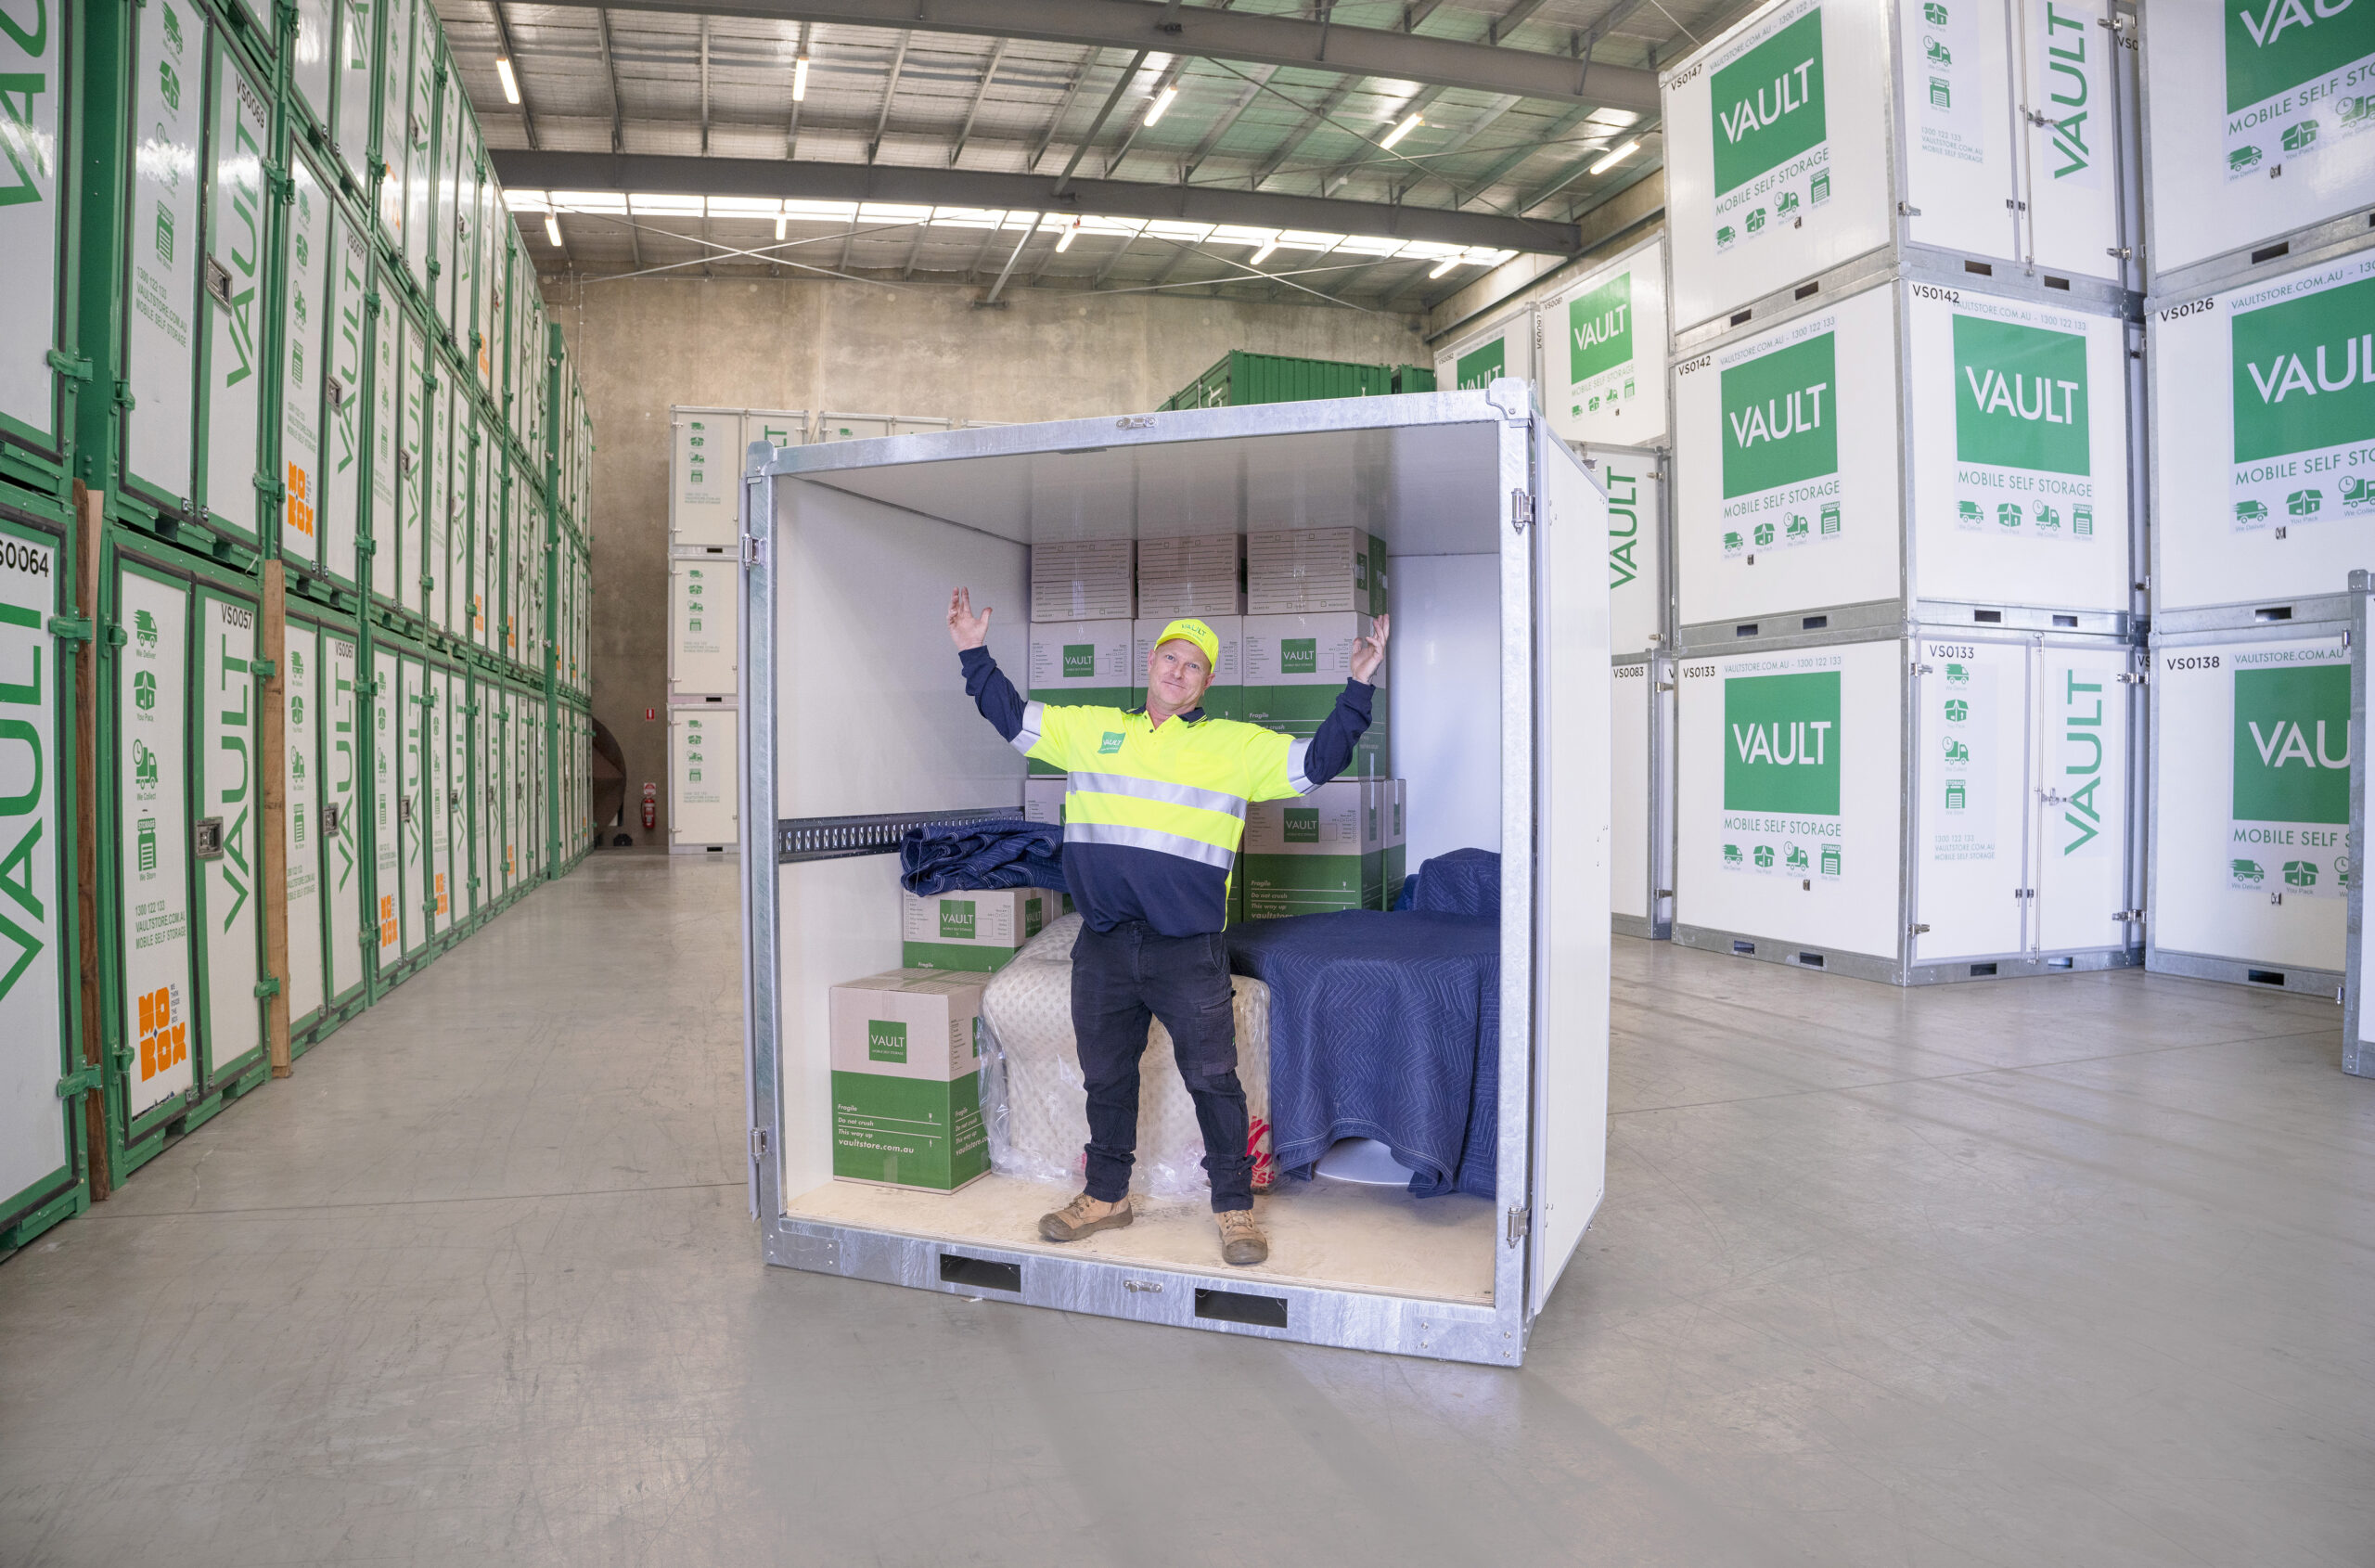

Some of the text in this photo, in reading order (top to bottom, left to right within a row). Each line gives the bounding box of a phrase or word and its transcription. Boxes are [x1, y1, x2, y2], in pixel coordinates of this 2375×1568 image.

[1710, 26, 1772, 71] VAULTSTORE.COM.AU
[1671, 64, 1702, 91] VS0147
[2048, 1, 2089, 179] VAULT
[236, 72, 264, 129] VS0069
[1720, 58, 1814, 145] VAULT
[2228, 78, 2338, 135] MOBILE SELF
[1921, 126, 1936, 135] 1300
[1952, 133, 1961, 141] 133
[1921, 136, 1983, 155] VAULTSTORE.COM.AU
[1922, 146, 1983, 163] MOBILE SELF STORAGE
[1715, 148, 1829, 216] MOBILE SELF STORAGE
[346, 228, 365, 263] VS0071
[136, 265, 167, 301] 1300 122 133
[1913, 284, 1959, 303] VS0142
[2231, 270, 2343, 310] VAULTSTORE.COM.AU
[135, 284, 187, 333] VAULTSTORE.COM.AU
[2161, 298, 2214, 322] VS0126
[135, 298, 186, 348] MOBILE SELF STORAGE
[1574, 304, 1626, 351] VAULT
[2040, 315, 2057, 326] 1300
[2060, 318, 2072, 328] 122
[2074, 320, 2086, 330] 133
[1720, 316, 1835, 365] VAULTSTORE.COM.AU 1300 122 133
[338, 249, 361, 474] VAULT
[1678, 355, 1711, 377] VS0142
[2247, 334, 2375, 405] VAUL
[1572, 365, 1635, 396] MOBILE SELF STORAGE
[1965, 366, 2078, 424] VAULT
[1729, 382, 1827, 449] VAULT
[408, 343, 421, 529] VAULT
[1958, 470, 2092, 497] MOBILE SELF STORAGE
[2236, 455, 2341, 485] MOBILE SELF
[456, 408, 467, 565] VAULT
[1724, 481, 1840, 519] MOBILE SELF STORAGE
[288, 491, 314, 538] BOX
[1607, 466, 1637, 589] VAULT
[2245, 522, 2266, 531] Deliver
[221, 603, 252, 630] VS0057
[1182, 623, 1206, 636] VAULT
[136, 649, 156, 660] We Deliver
[335, 641, 353, 660] VS0061
[1065, 656, 1093, 664] VAULT
[1283, 651, 1314, 661] VAULT
[1930, 645, 1974, 659] VS0133
[2167, 656, 2220, 670] VS0138
[2235, 649, 2344, 664] VAULTSTORE.COM.AU
[1613, 667, 1644, 678] VS0083
[1683, 666, 1715, 678] VS0133
[1725, 657, 1841, 673] VAULTSTORE.COM.AU 1300 122 133
[136, 713, 154, 722] You Pack
[1733, 721, 1831, 765] VAULT
[2248, 720, 2350, 769] VAU
[409, 680, 419, 868] VAULT
[456, 693, 465, 853] VAULT
[2064, 669, 2102, 855] VAULT
[221, 634, 249, 935] VAULT
[336, 662, 353, 894] VAULT
[137, 791, 156, 801] We Collect
[137, 818, 156, 829] STORAGE
[1286, 820, 1317, 829] VAULT
[1724, 817, 1841, 837] MOBILE SELF STORAGE
[1935, 843, 1995, 852] VAULTSTORE.COM.AU
[2233, 829, 2338, 847] MOBILE SELF
[1935, 853, 1956, 861] MOBILE
[1970, 852, 1995, 860] STORAGE
[139, 870, 156, 881] We Store
[135, 900, 165, 916] 1300 122 133
[942, 913, 973, 924] VAULT
[1026, 911, 1042, 922] VAULT
[135, 926, 186, 950] MOBILE SELF STORAGE
[138, 986, 170, 1037] MO
[140, 1022, 186, 1082] BOX
[871, 1035, 905, 1047] VAULT
[955, 1107, 968, 1117] Fragile
[839, 1139, 914, 1153] vaultstore.com.au
